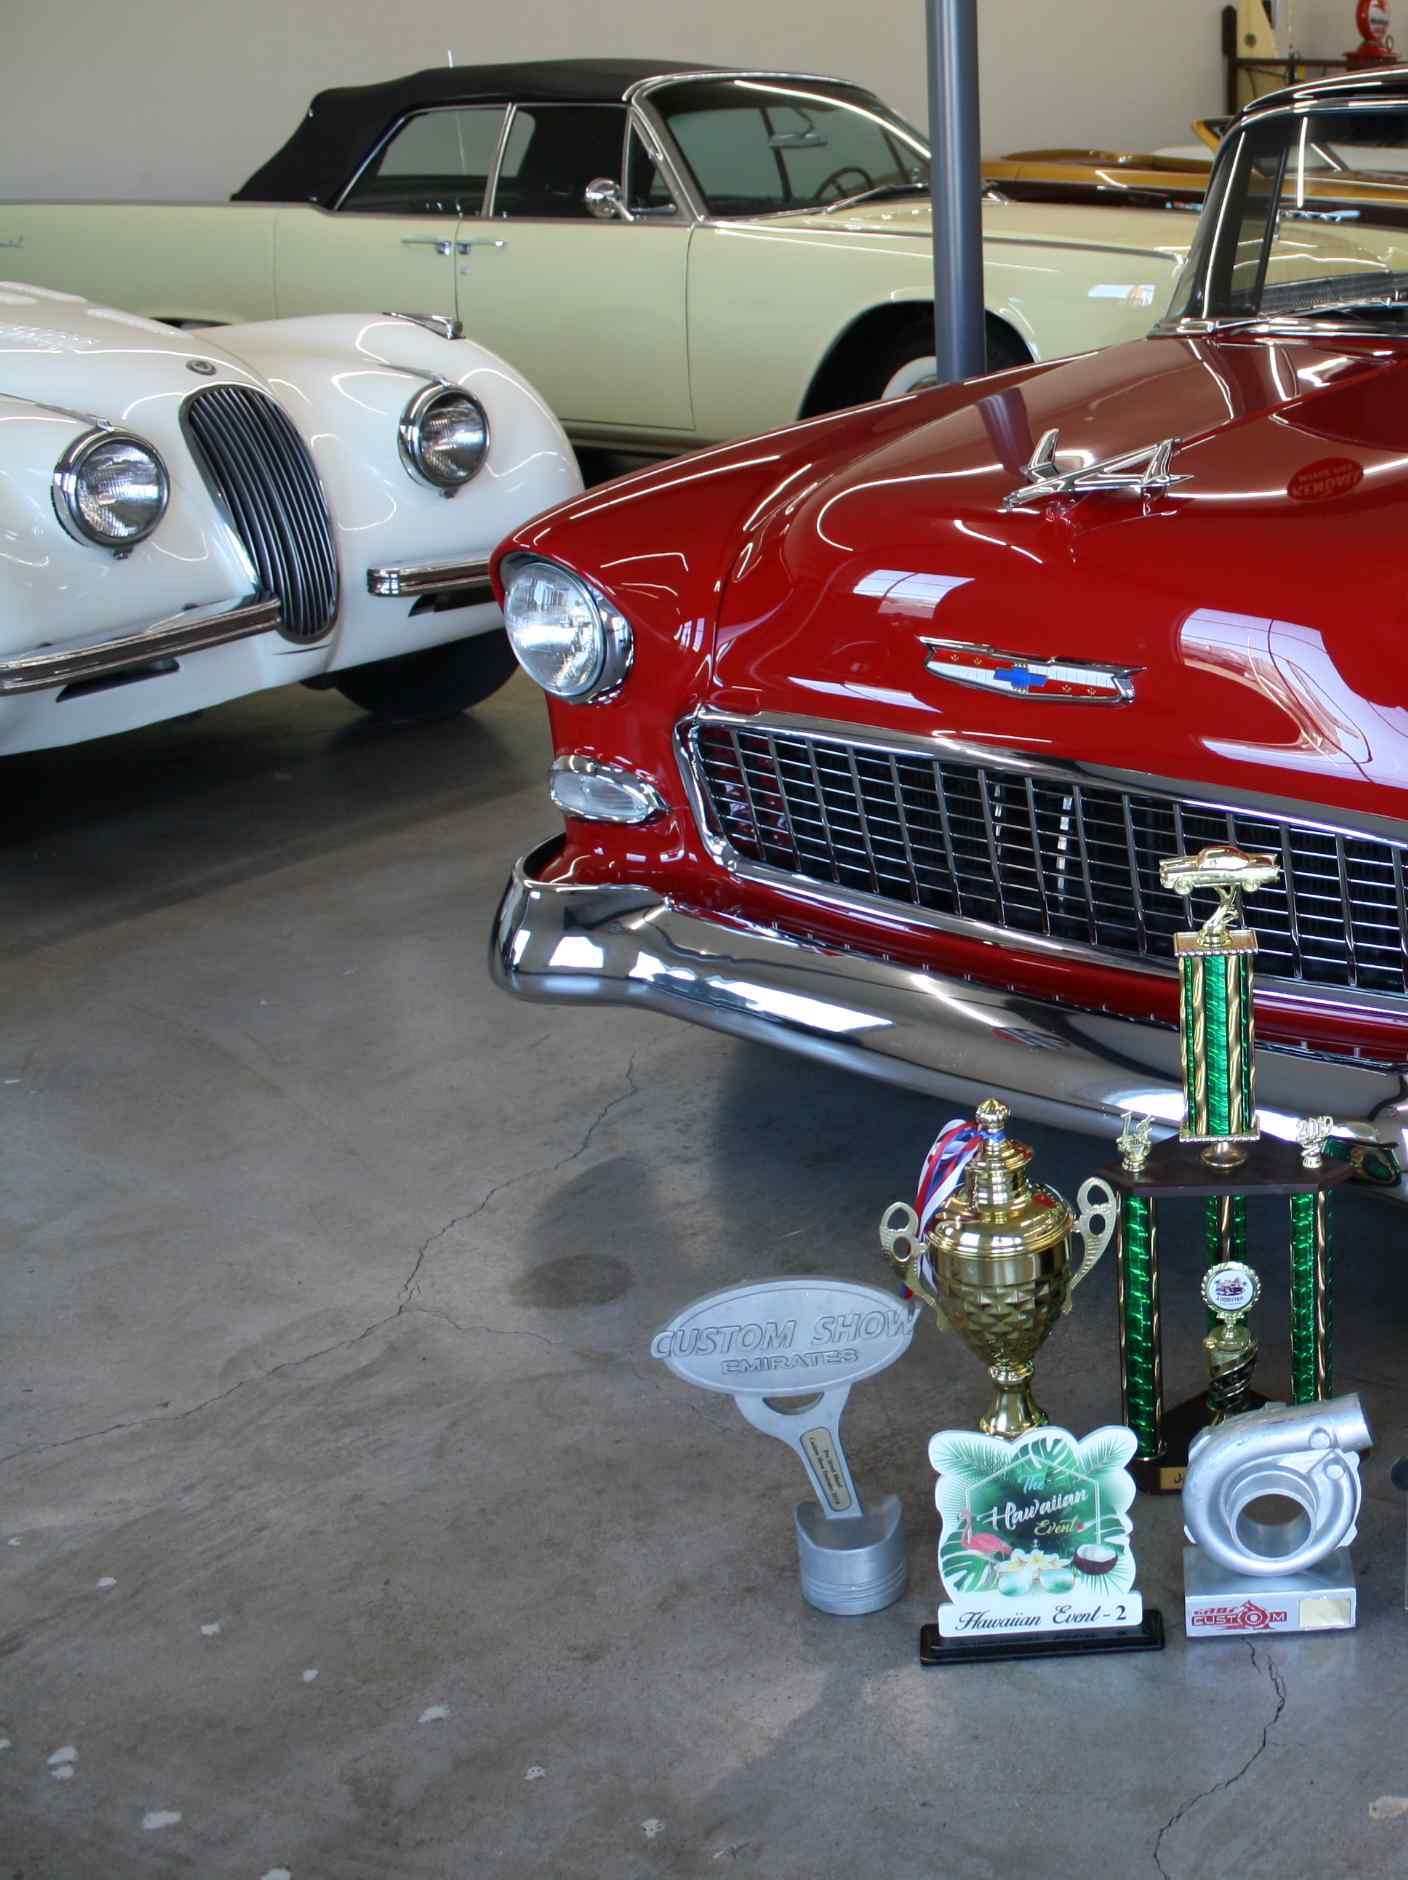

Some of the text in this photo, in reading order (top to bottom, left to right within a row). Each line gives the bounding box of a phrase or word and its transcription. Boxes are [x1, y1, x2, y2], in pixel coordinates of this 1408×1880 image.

[652, 1308, 920, 1359] CUSTOM SHOW
[720, 1349, 859, 1375] EMIRATES
[977, 1488, 1088, 1531] Hawaiian
[1034, 1515, 1080, 1536] Event
[955, 1609, 1041, 1632] Hawaiian
[1052, 1604, 1103, 1625] Event
